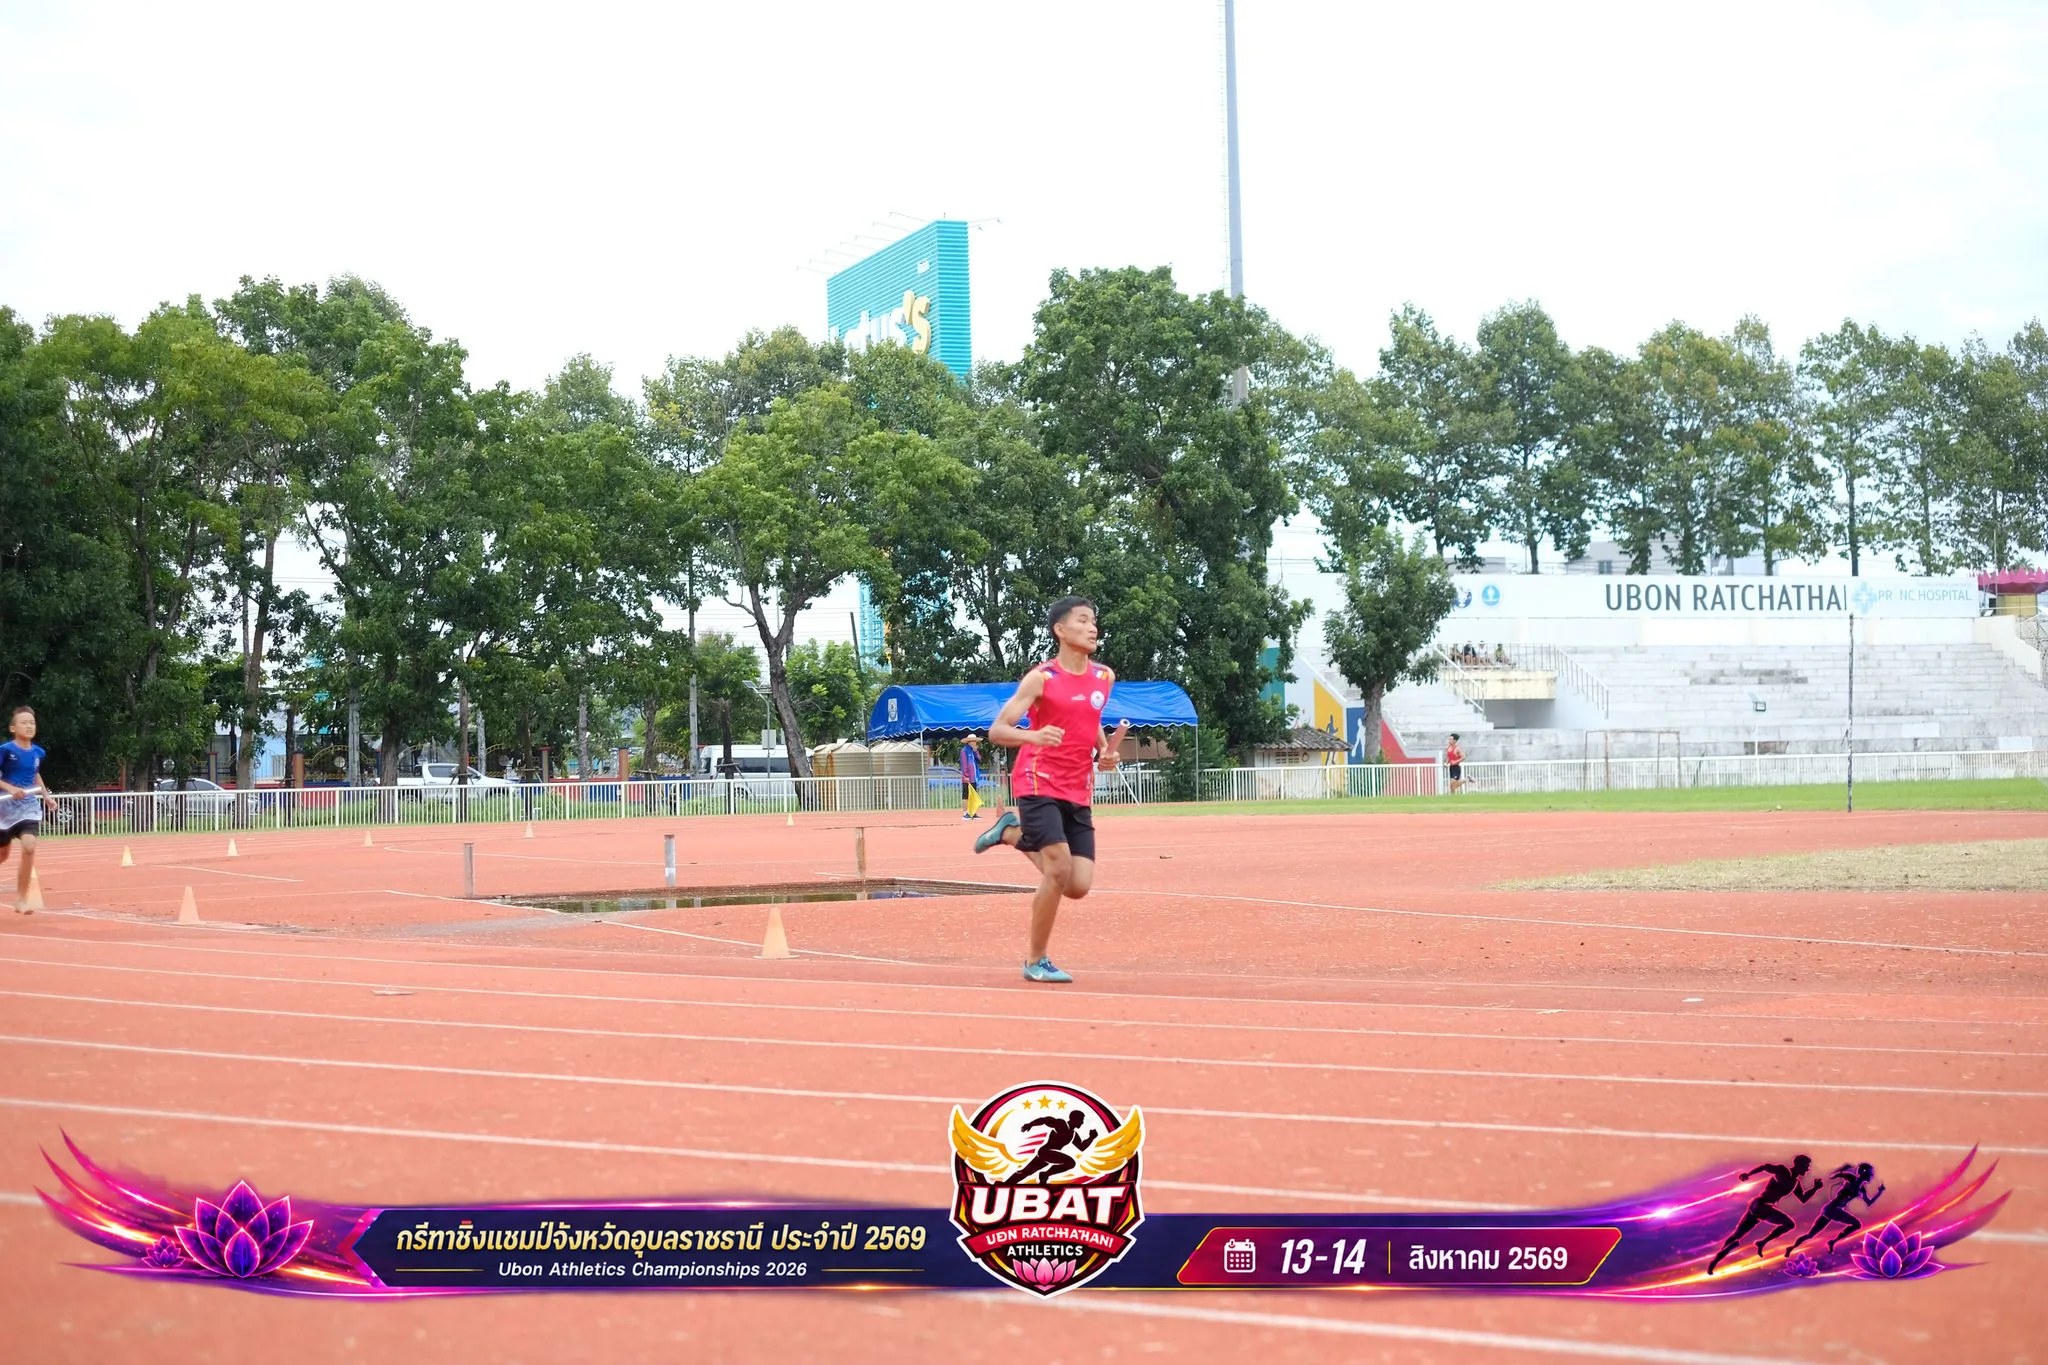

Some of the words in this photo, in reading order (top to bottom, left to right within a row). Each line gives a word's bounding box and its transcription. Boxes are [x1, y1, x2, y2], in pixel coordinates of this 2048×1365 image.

[1605, 583, 1681, 611] UBON
[1692, 584, 1847, 611] RATCHATHA
[1877, 589, 1914, 601] PRNC
[1918, 589, 1972, 601] HOSPITAL
